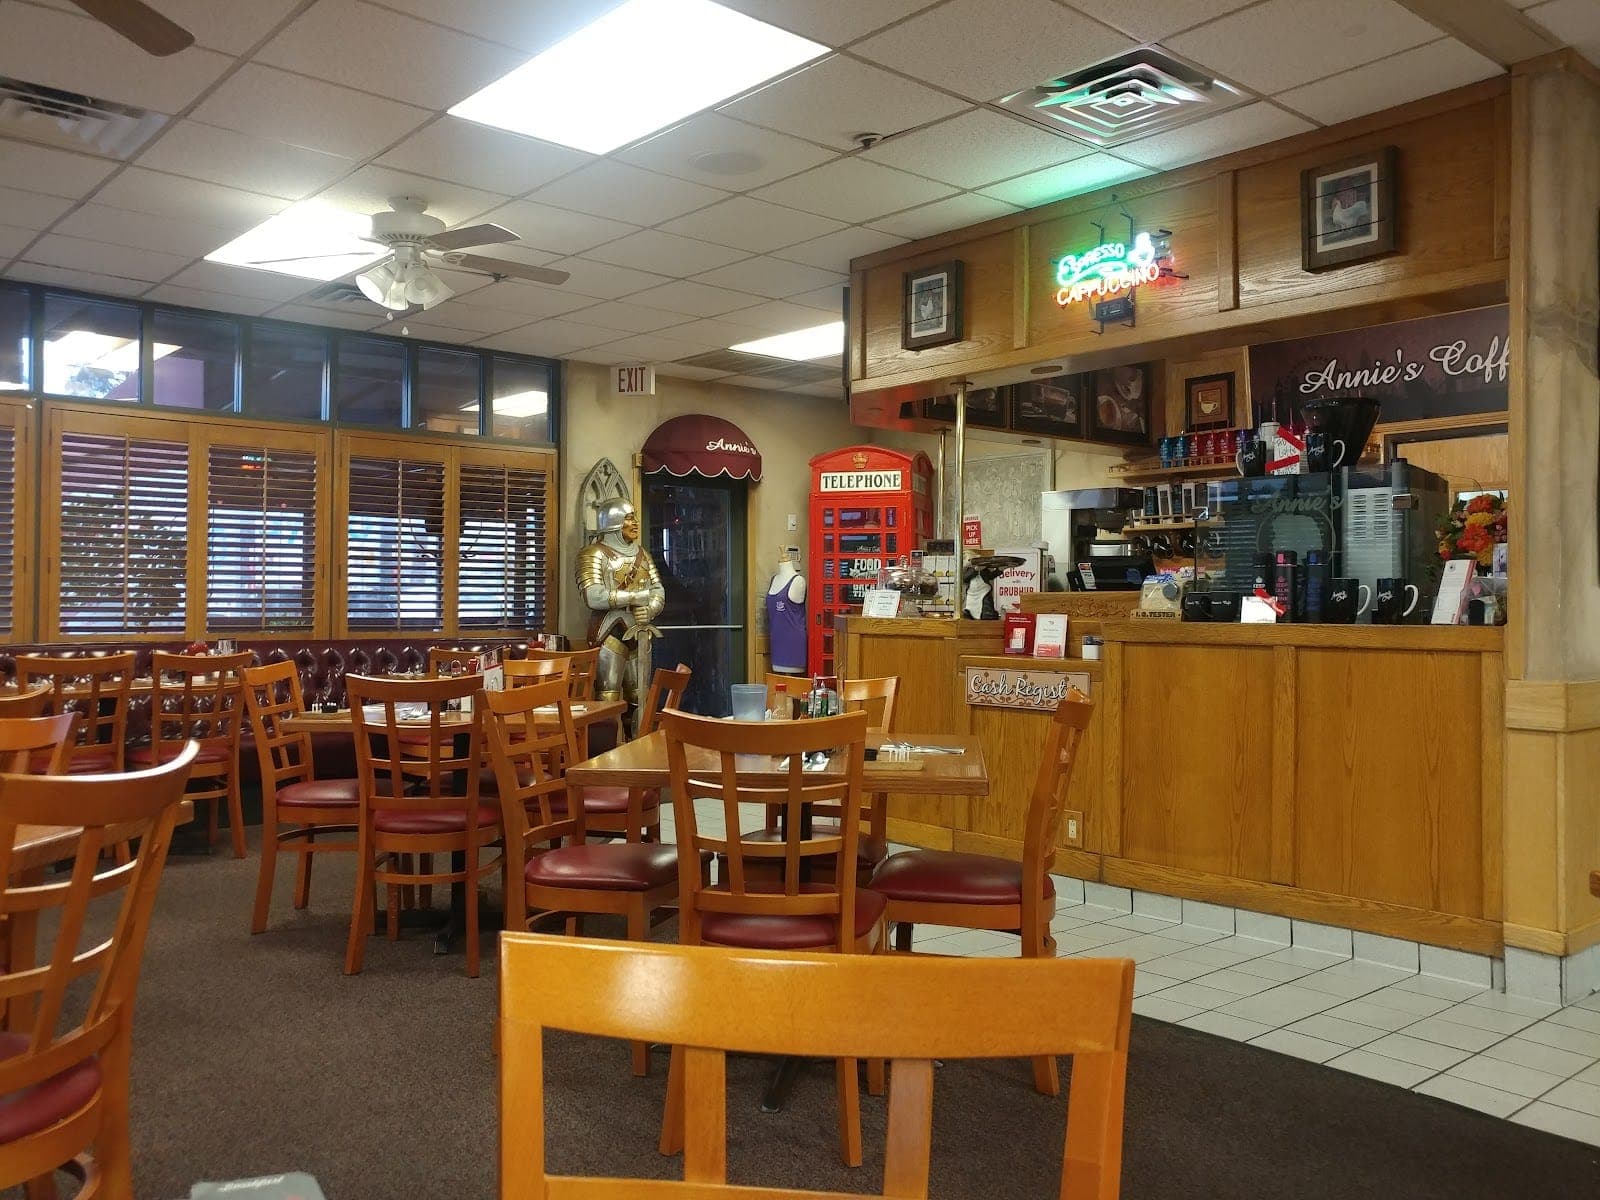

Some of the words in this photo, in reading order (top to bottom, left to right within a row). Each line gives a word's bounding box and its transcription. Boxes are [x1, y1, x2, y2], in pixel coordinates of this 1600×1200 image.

[1056, 262, 1160, 305] CAPPUCCINO
[618, 367, 646, 392] EXIT
[1300, 349, 1424, 394] Annie's
[1429, 336, 1510, 384] Coff
[823, 473, 900, 489] TELEPHONE
[970, 672, 1013, 696] Cash
[1015, 676, 1068, 705] Regist
